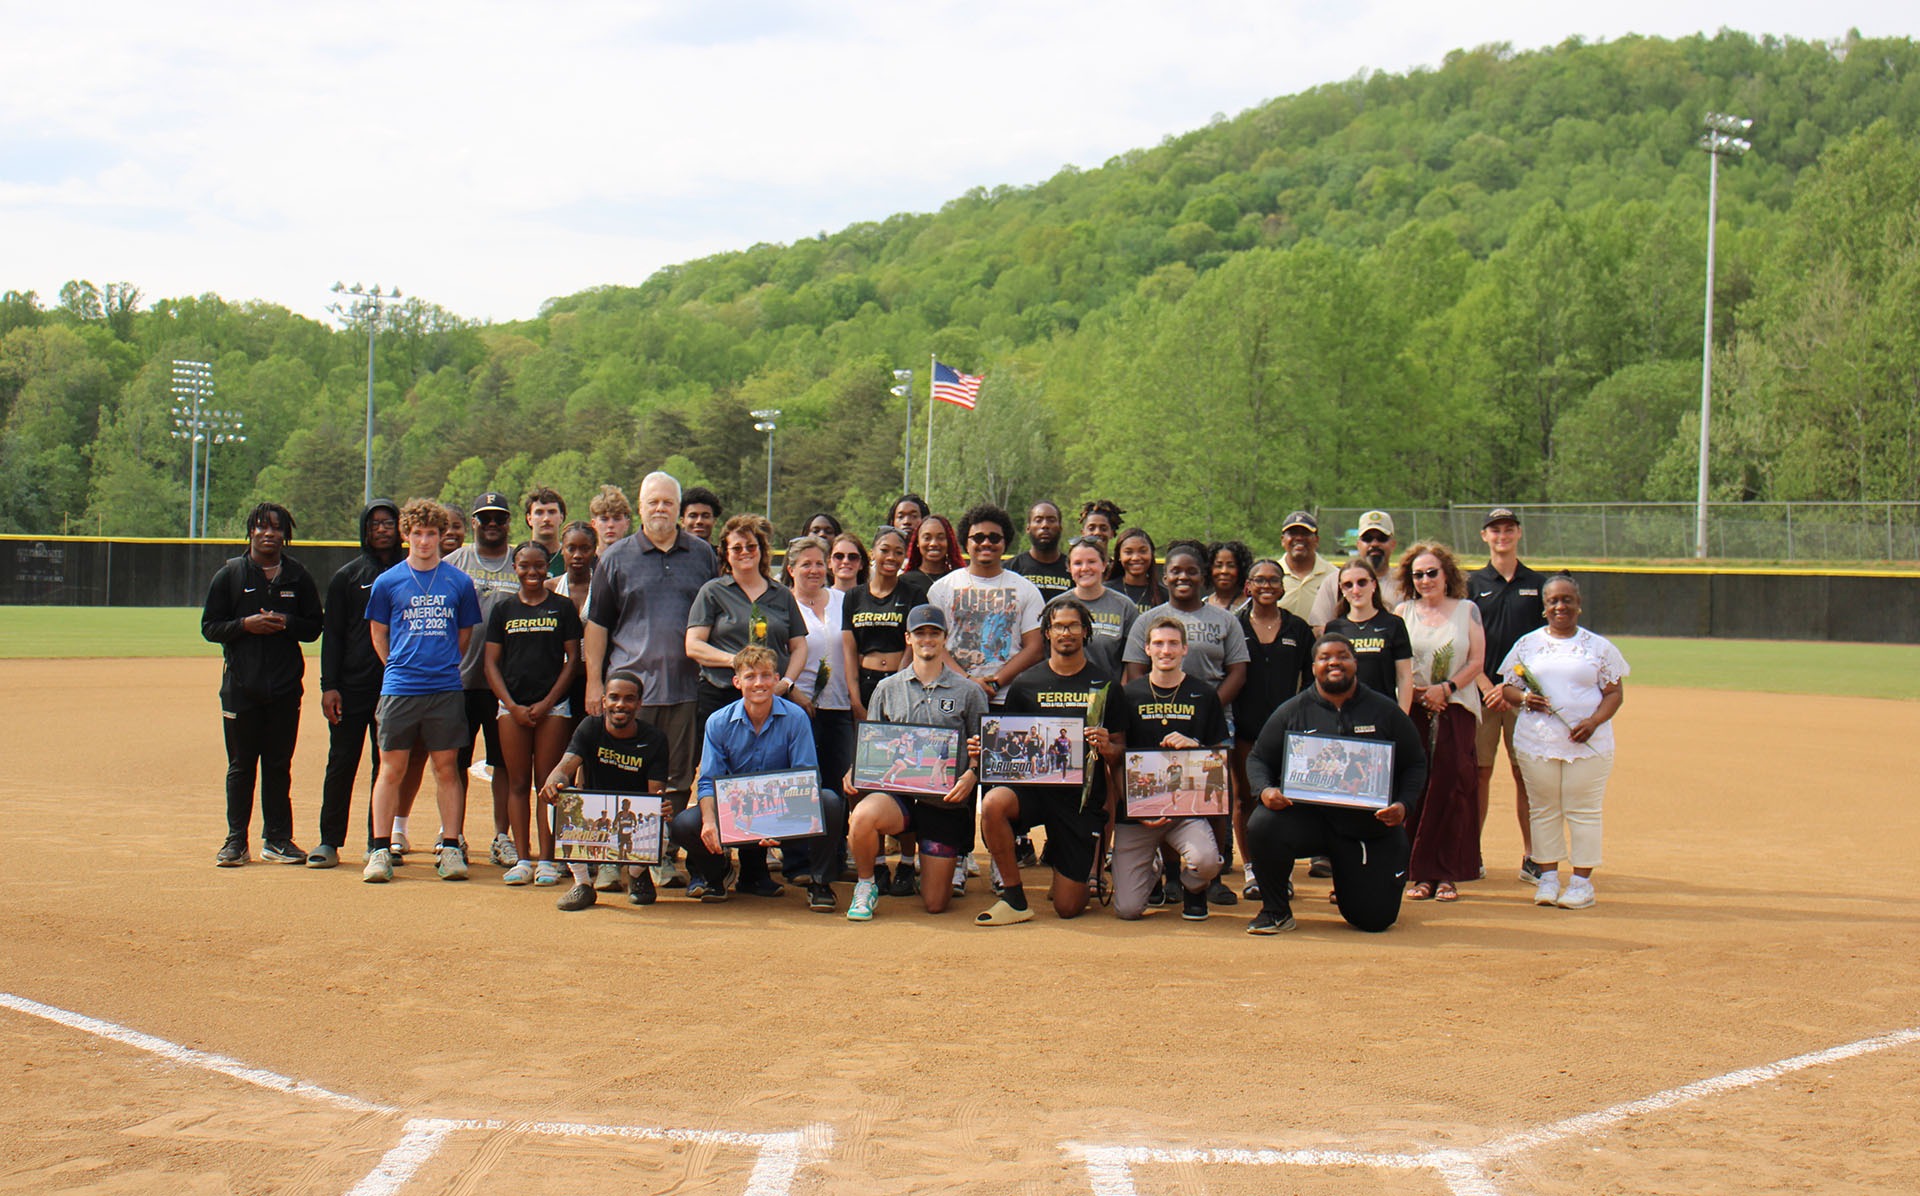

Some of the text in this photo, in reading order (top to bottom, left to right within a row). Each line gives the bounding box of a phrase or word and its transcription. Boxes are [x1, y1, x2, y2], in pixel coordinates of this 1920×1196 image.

[486, 494, 497, 505] F
[466, 568, 520, 583] ERRUM
[411, 594, 447, 607] GREAT
[403, 606, 455, 620] AMERICAN
[852, 611, 903, 624] FERRUM
[409, 618, 448, 631] XC 2024
[505, 617, 558, 630] FERRUM
[1186, 622, 1221, 635] RUM
[1187, 631, 1221, 646] ETICS
[1138, 703, 1195, 716] FERRUM
[597, 746, 643, 769] FERRUM
[990, 760, 1033, 773] LAWSON
[783, 787, 812, 799] MILLS
